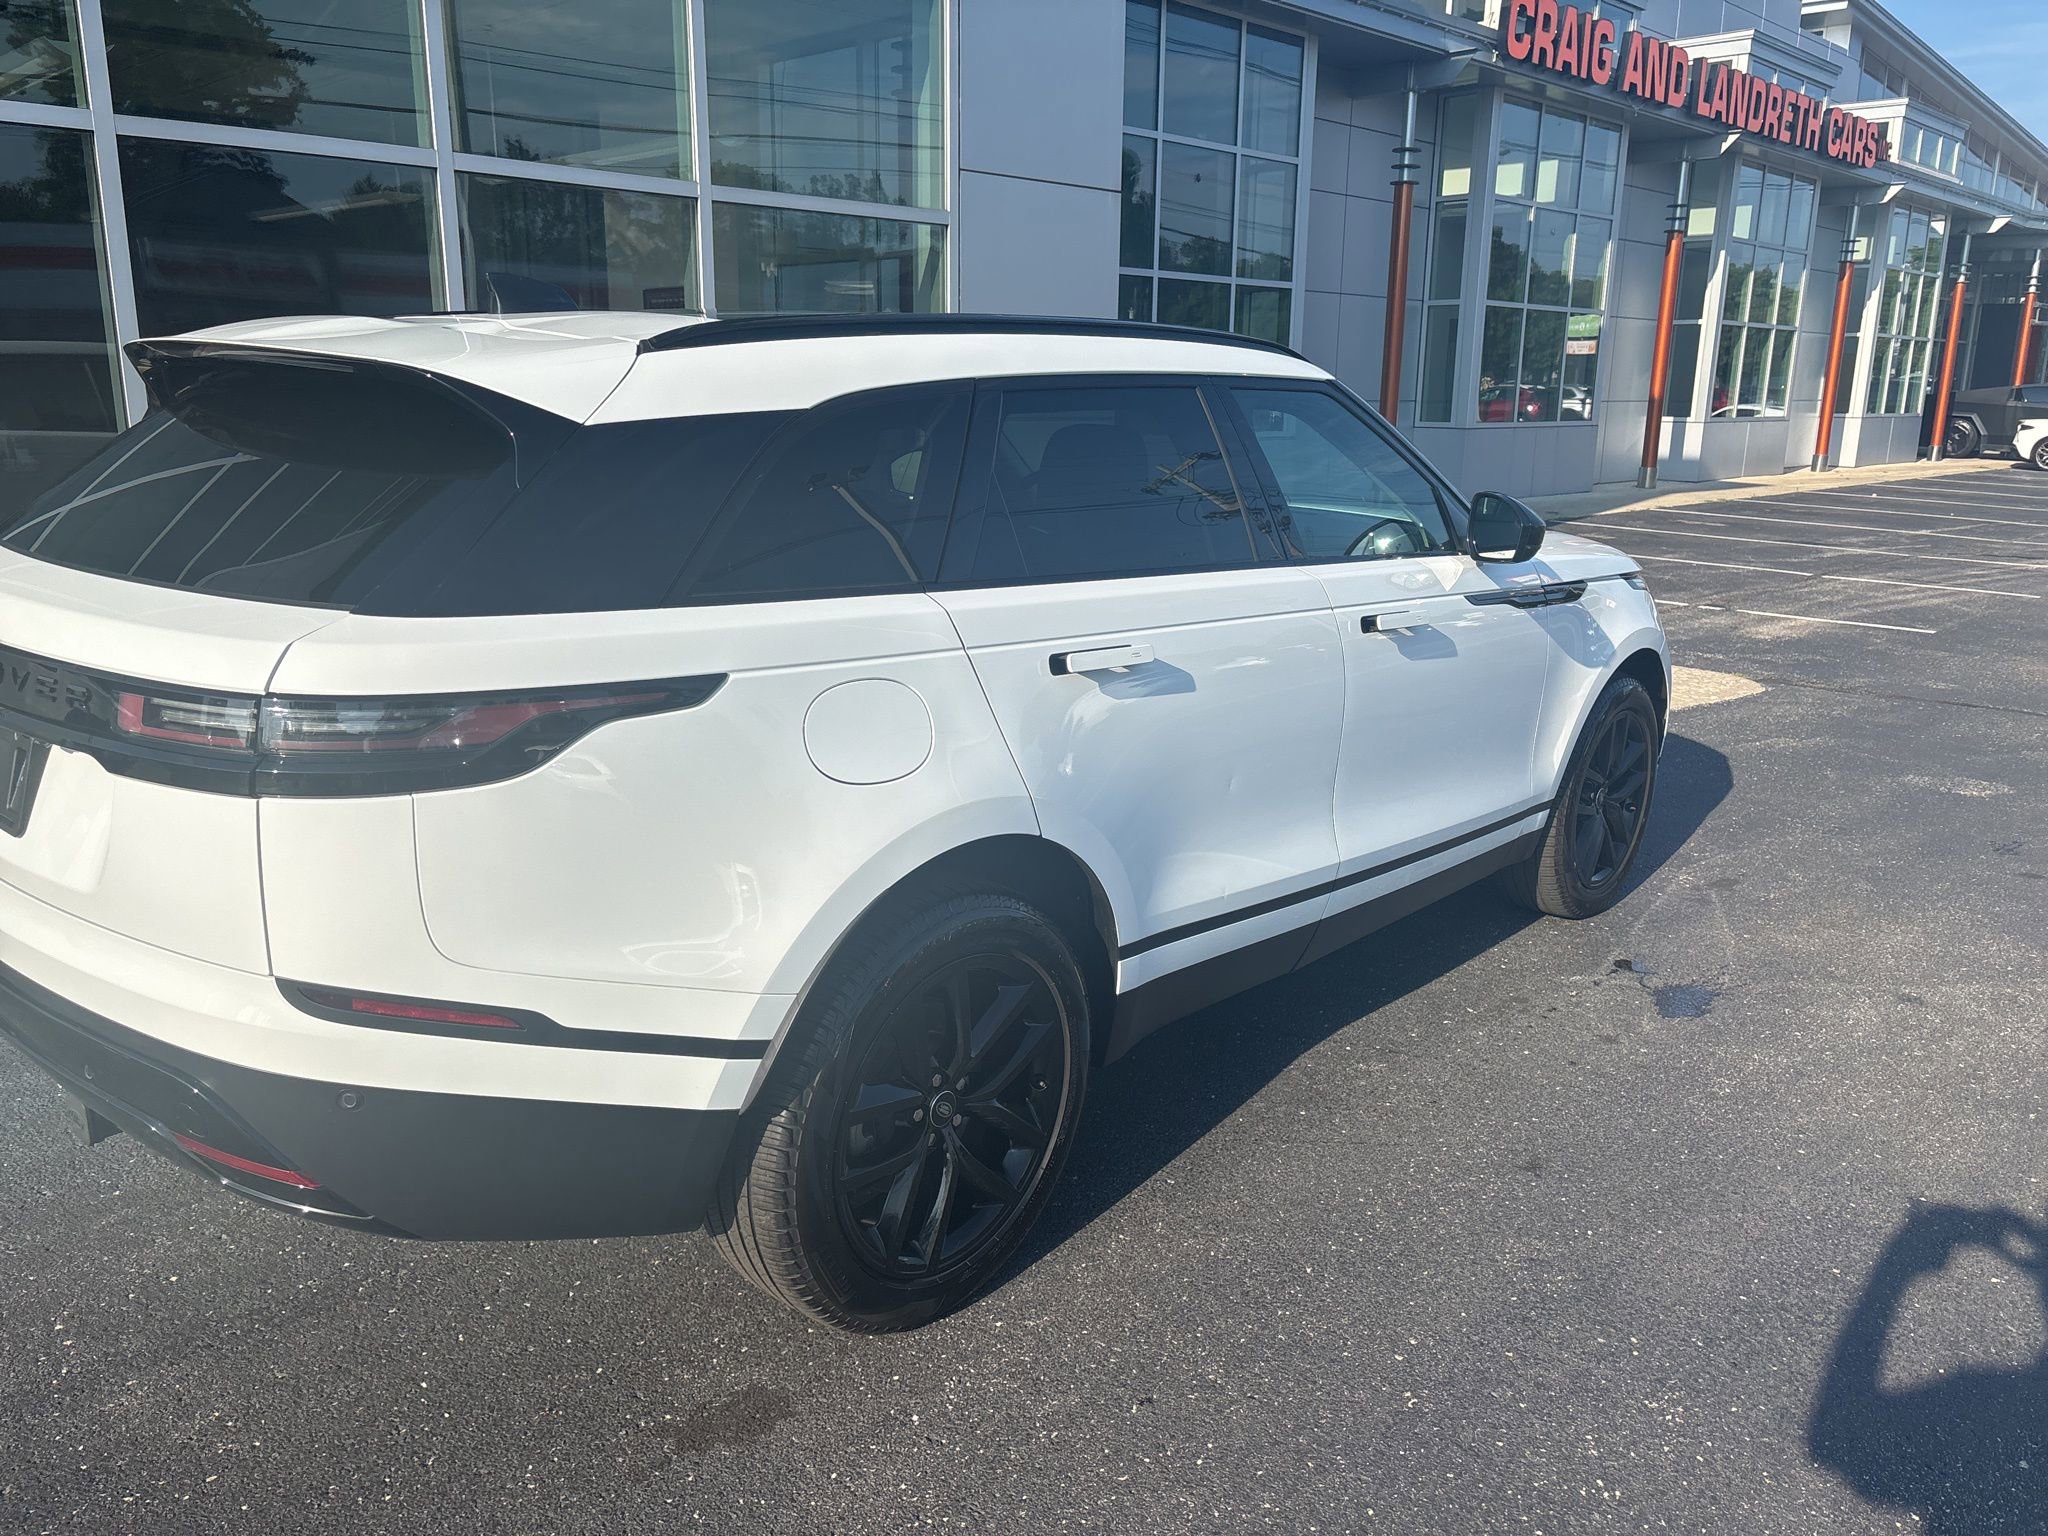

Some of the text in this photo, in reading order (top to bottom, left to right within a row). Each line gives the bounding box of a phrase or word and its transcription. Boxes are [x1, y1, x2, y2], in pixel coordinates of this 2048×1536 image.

[1507, 0, 1616, 85] CRAIG
[1622, 31, 1689, 108] AND
[1697, 57, 1823, 152] LANDRETH
[1827, 107, 1878, 169] CARS
